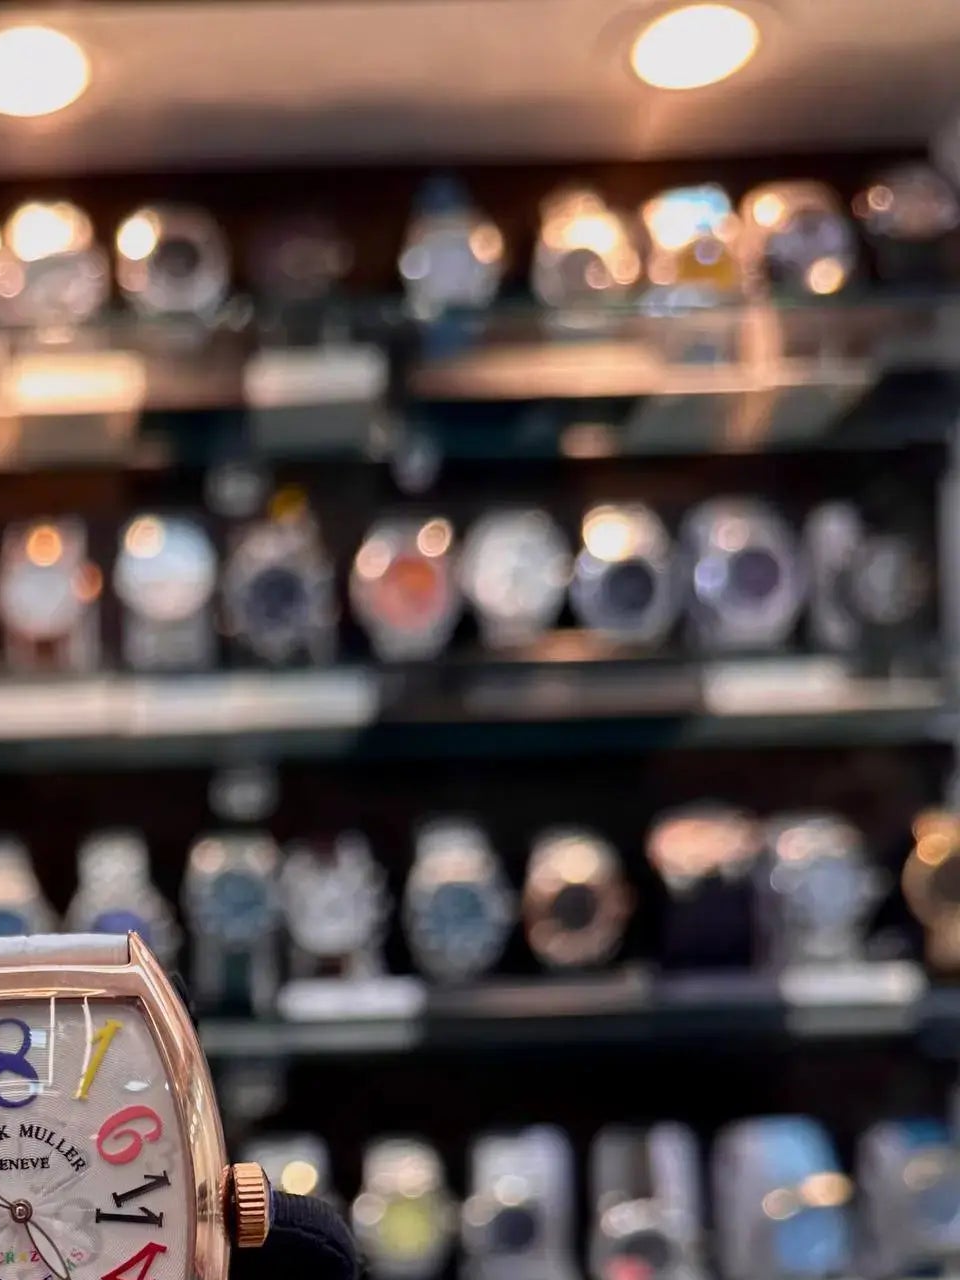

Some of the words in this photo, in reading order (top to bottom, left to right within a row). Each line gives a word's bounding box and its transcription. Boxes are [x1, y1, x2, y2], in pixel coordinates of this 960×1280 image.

[75, 1018, 123, 1100] 1
[19, 1124, 86, 1172] MULLER
[97, 1105, 163, 1165] 6
[96, 1170, 171, 1228] 11
